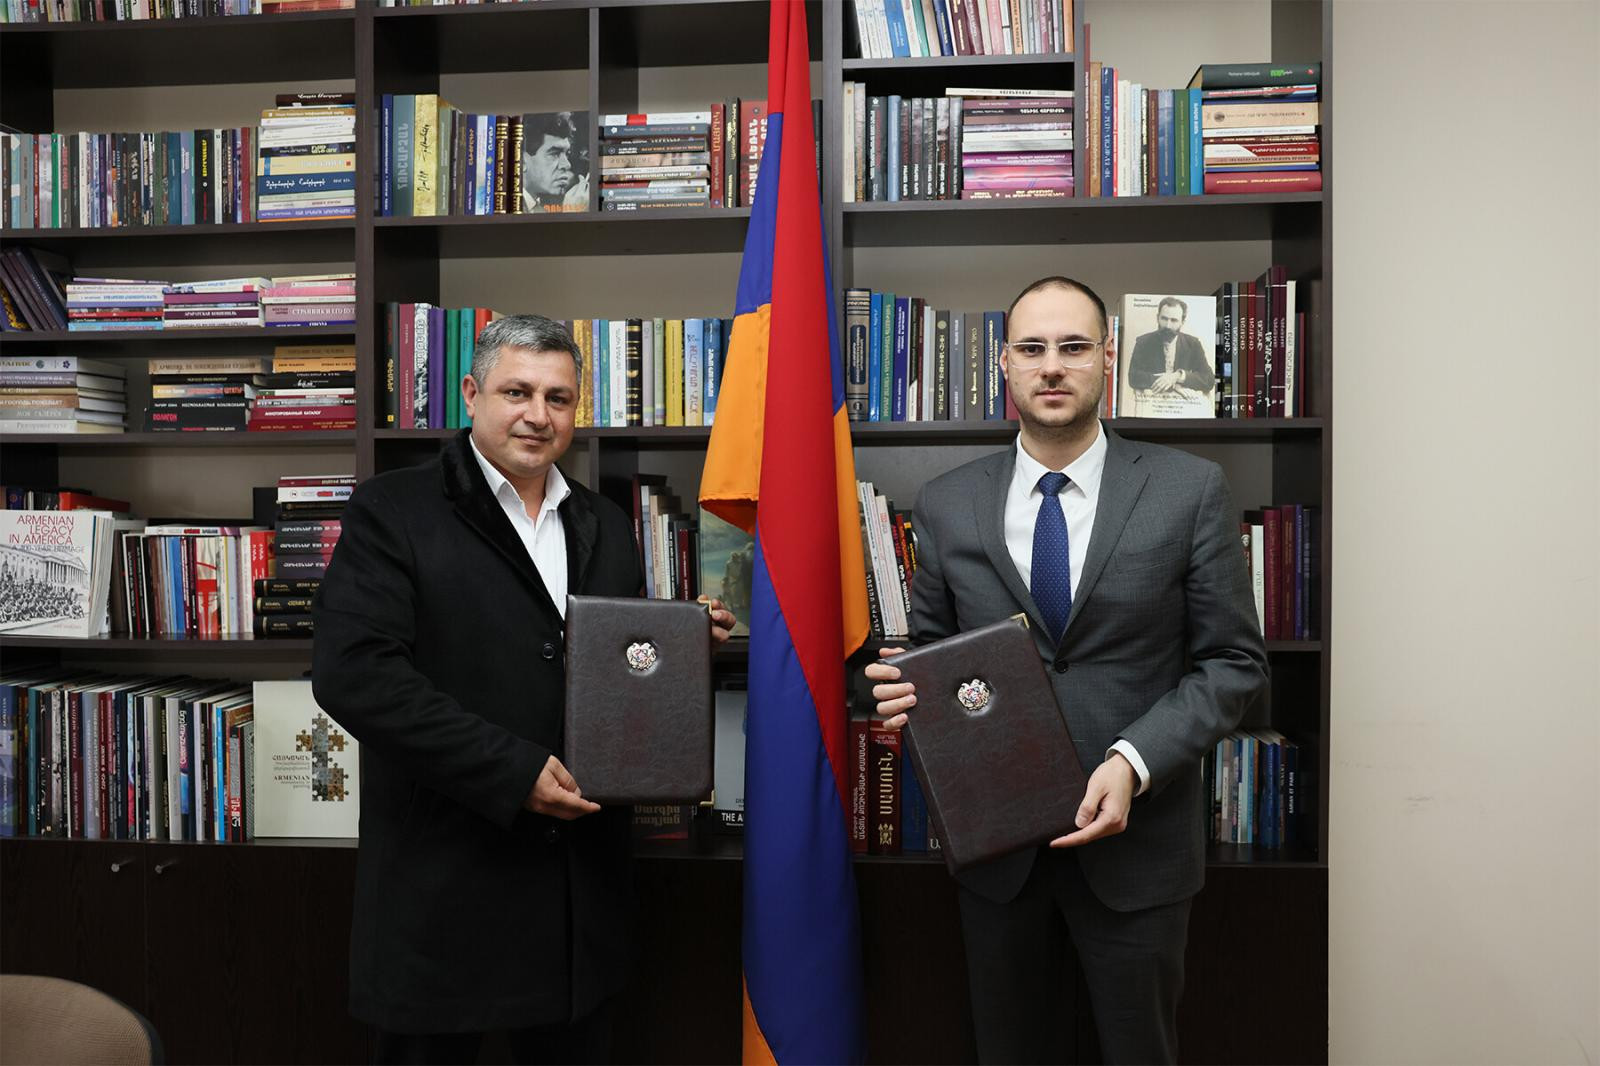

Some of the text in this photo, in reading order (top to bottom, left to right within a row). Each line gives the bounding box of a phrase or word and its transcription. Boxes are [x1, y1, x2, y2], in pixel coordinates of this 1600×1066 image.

[748, 118, 758, 160] ԼԵՌԱՆ
[16, 514, 75, 526] ARMENIAN
[29, 525, 75, 537] LEGACY
[9, 533, 73, 545] IN AMERICA
[878, 752, 894, 815] ՍԱՍՈՒՆ
[721, 812, 735, 822] THE
